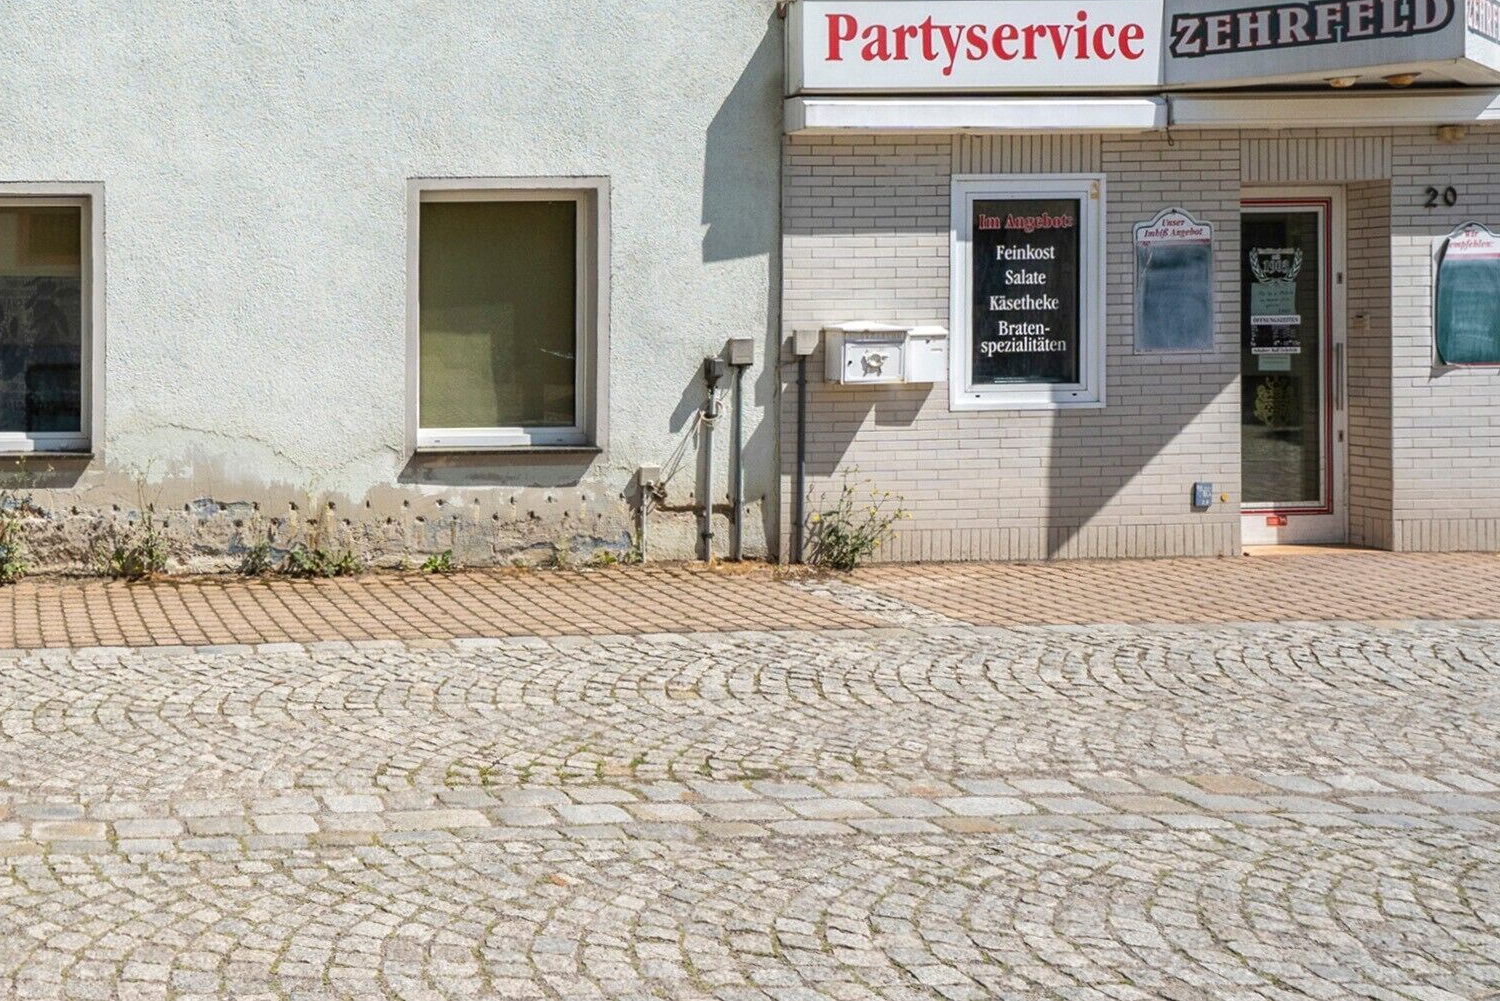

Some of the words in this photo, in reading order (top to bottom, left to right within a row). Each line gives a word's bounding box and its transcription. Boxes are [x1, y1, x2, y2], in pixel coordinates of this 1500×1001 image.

[824, 9, 1145, 77] Partyservice
[1424, 186, 1457, 208] 20
[979, 213, 1001, 230] Im
[1004, 212, 1074, 234] Angebot:
[1161, 219, 1185, 227] Unser
[1171, 226, 1204, 238] Angebot
[995, 243, 1056, 260] Feinkost
[1004, 268, 1047, 285] Salate
[989, 293, 1060, 312] Käsetheke
[998, 320, 1051, 336] Braten-
[980, 336, 1067, 358] spezialitäten
